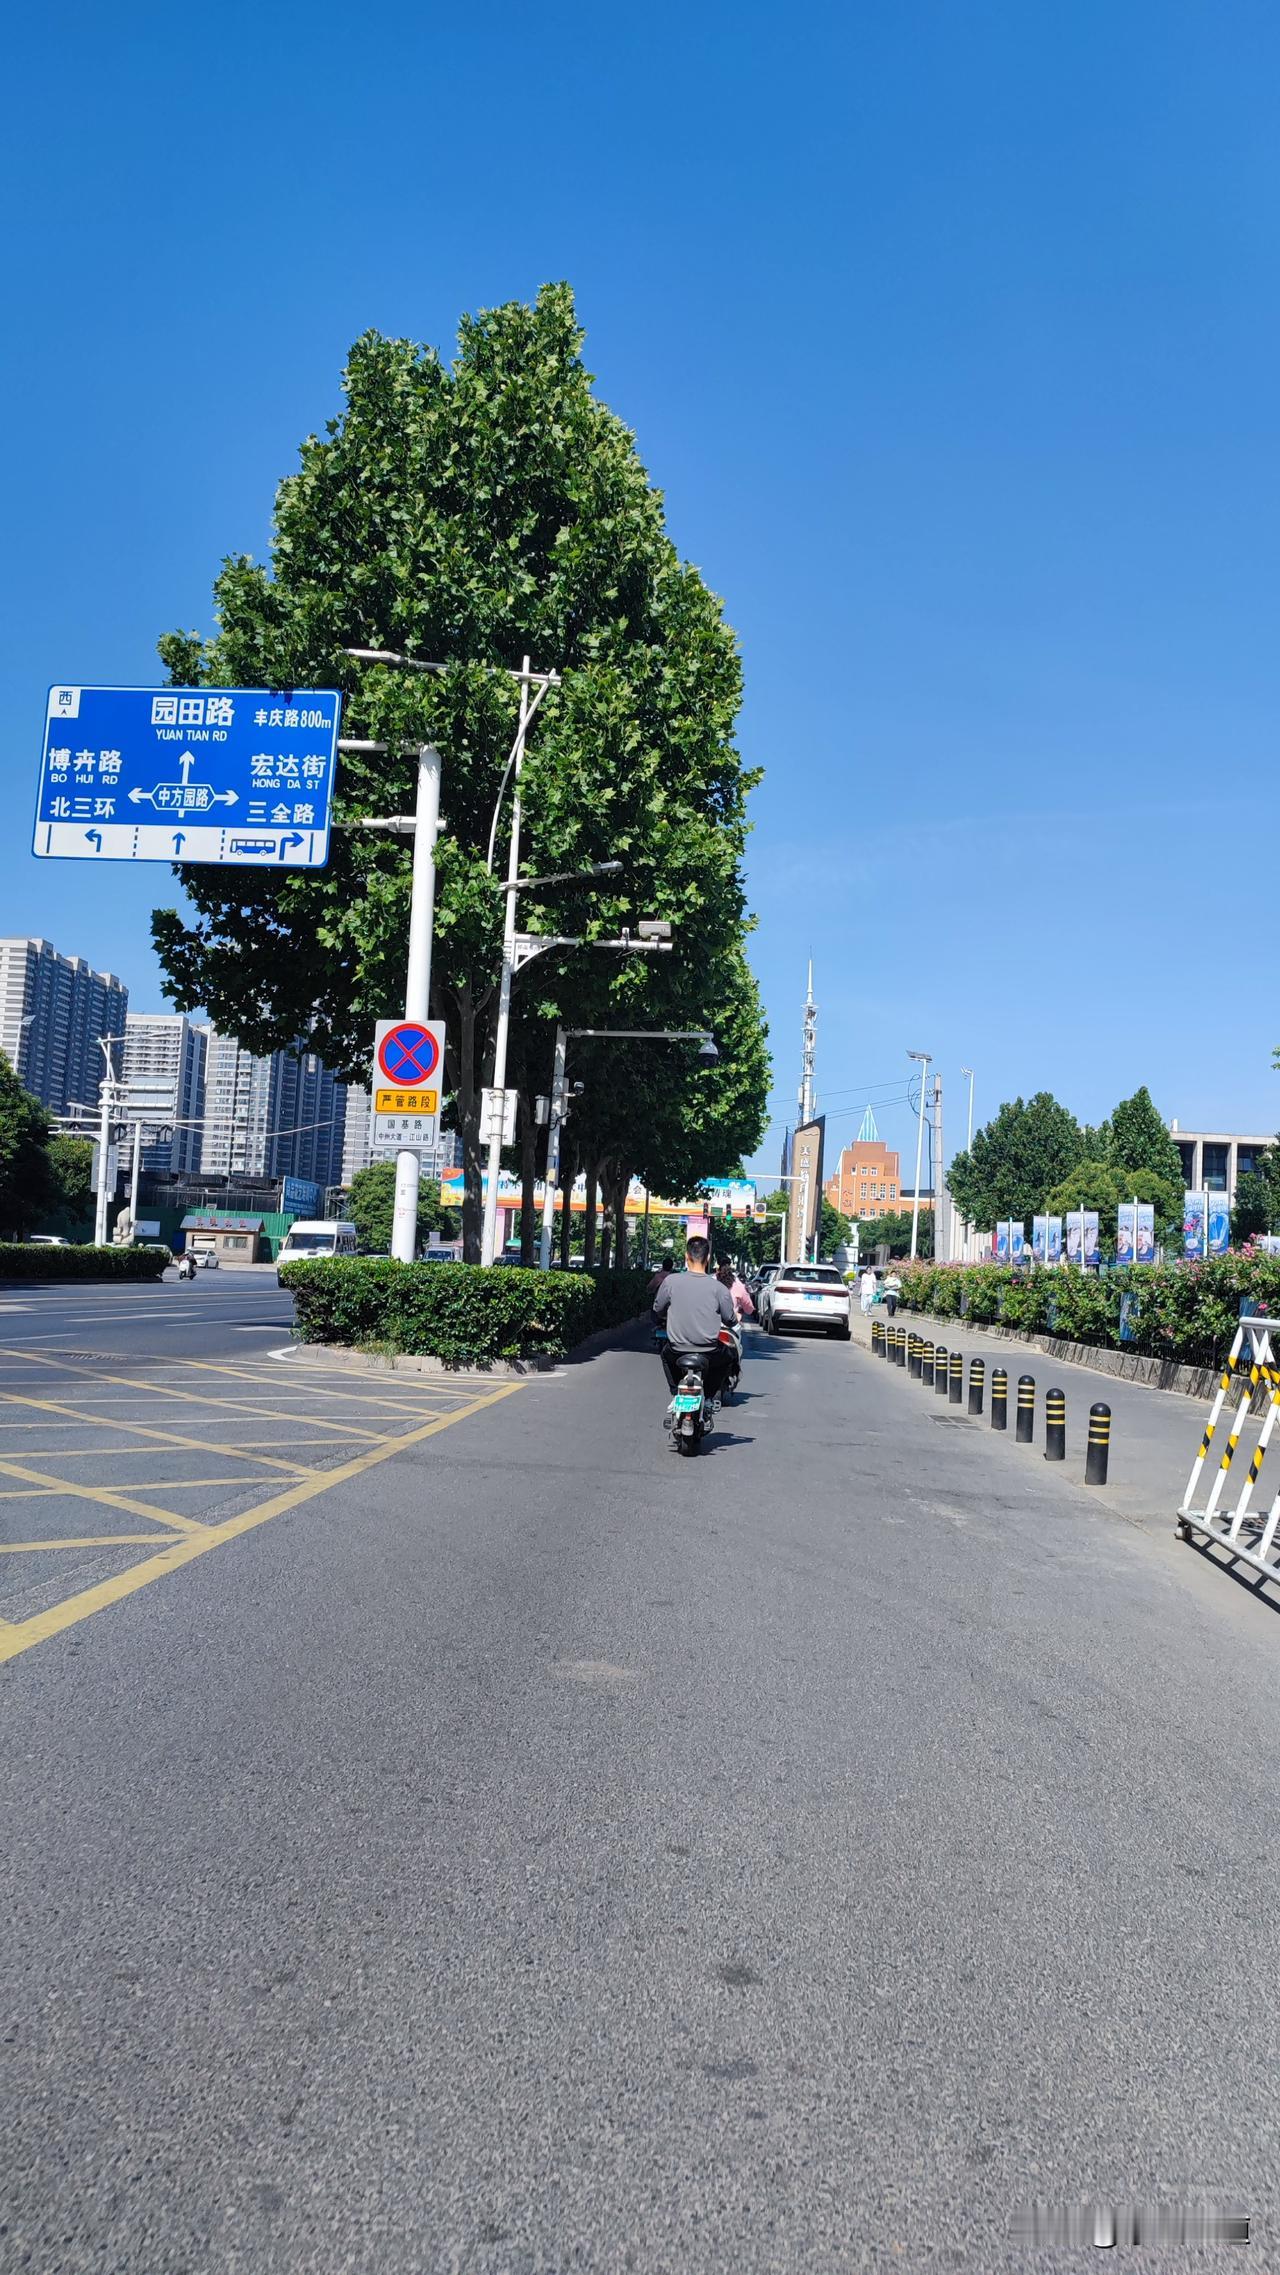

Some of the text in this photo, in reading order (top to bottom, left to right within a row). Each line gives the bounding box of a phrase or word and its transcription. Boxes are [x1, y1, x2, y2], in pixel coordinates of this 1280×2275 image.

[59, 691, 73, 706] 西
[151, 696, 235, 726] 园田路
[253, 708, 331, 729] 丰庆路800m
[156, 729, 228, 742] YUAN TIAN RD
[48, 747, 123, 773] 博卉路
[250, 753, 327, 778] 宏达街
[50, 773, 118, 785] BO HUI RD
[252, 778, 320, 791] HONG DA ST
[49, 796, 116, 819] 北三环
[158, 787, 209, 808] 中方园路
[246, 801, 315, 825] 三全路
[383, 1095, 430, 1108] 严管路段
[387, 1119, 422, 1130] 国基路
